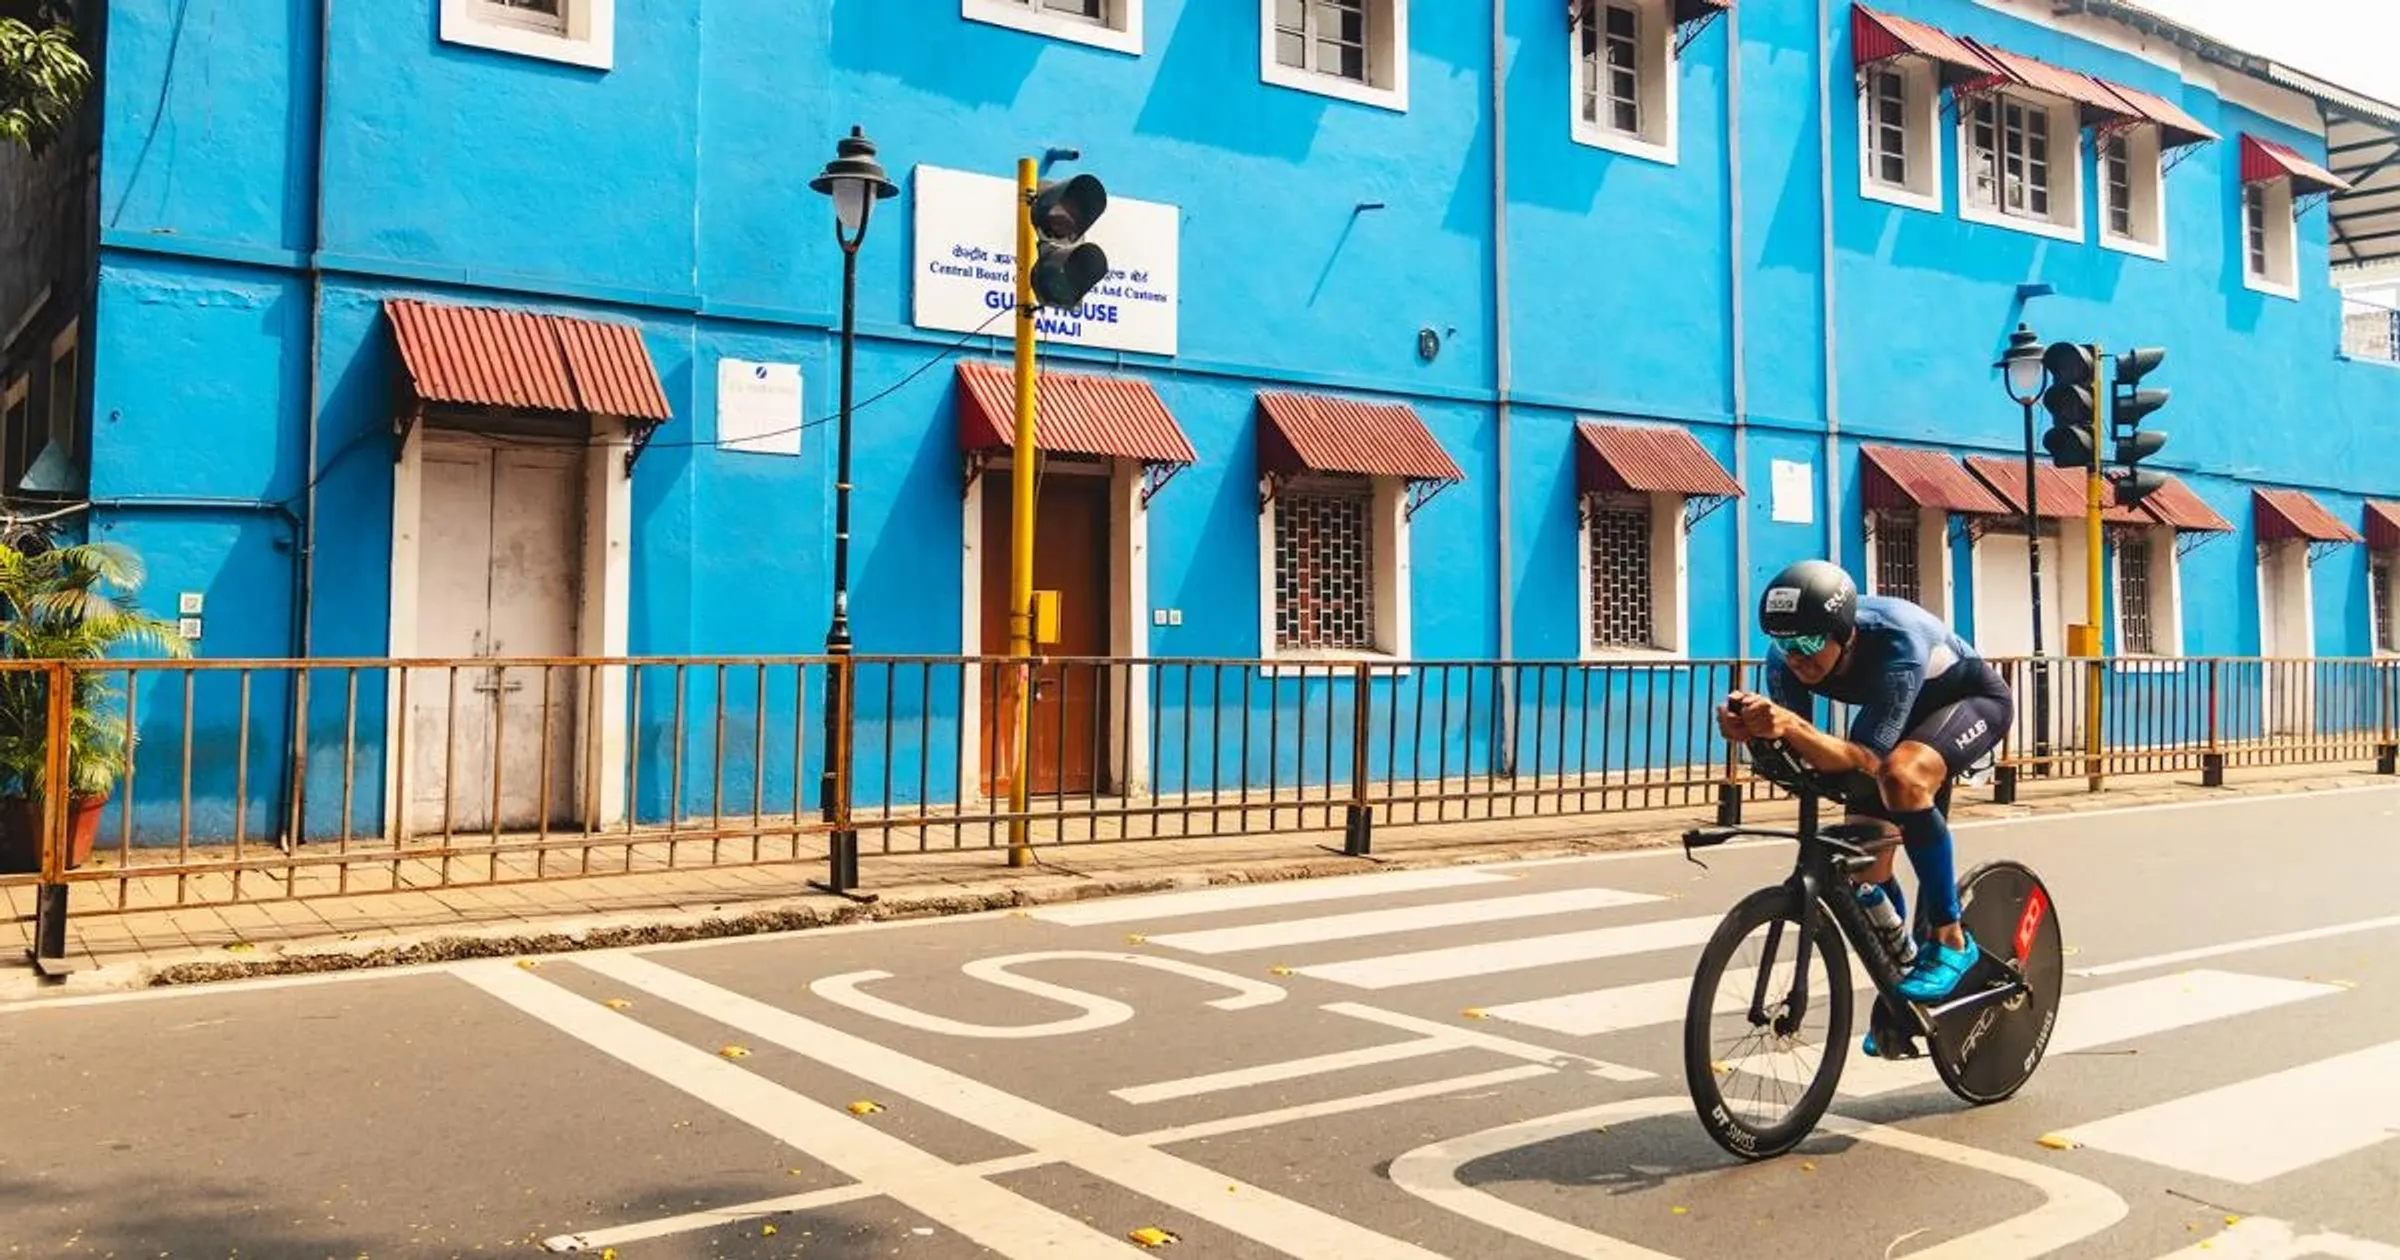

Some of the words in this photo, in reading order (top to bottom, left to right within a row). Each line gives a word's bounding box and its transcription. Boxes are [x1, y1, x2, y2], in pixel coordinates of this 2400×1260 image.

[930, 261, 973, 277] Central
[976, 267, 1009, 282] Board
[1101, 286, 1122, 297] And
[1124, 286, 1167, 302] Customs
[1035, 318, 1081, 337] ANAJI
[2023, 1048, 2036, 1072] DT
[1712, 1104, 1729, 1127] DT
[1726, 1123, 1758, 1150] SWISS
